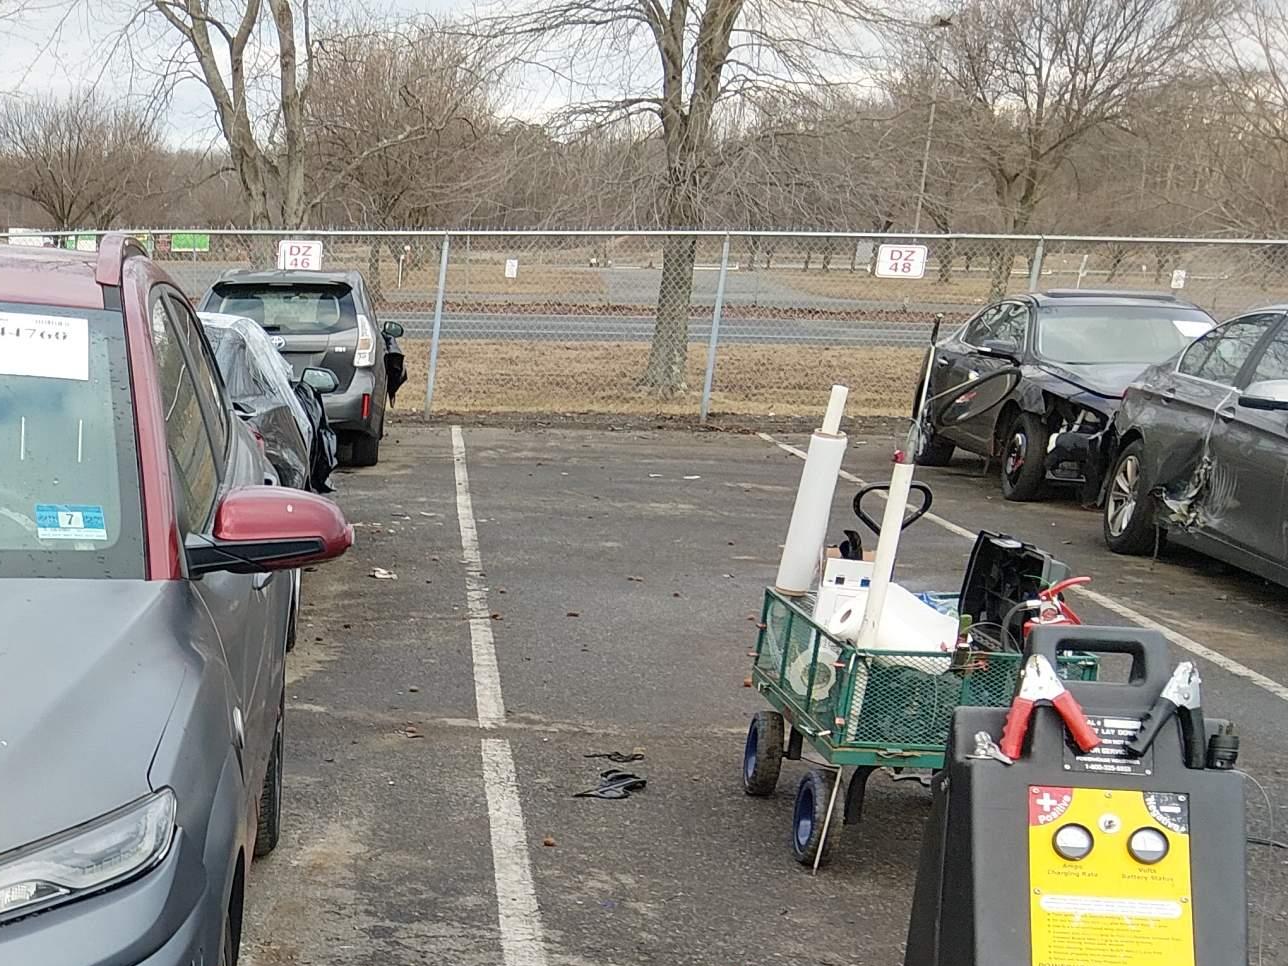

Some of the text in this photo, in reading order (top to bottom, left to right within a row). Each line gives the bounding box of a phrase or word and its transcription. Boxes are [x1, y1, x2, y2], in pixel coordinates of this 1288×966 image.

[289, 245, 313, 257] DZ
[890, 249, 917, 262] DZ
[289, 257, 310, 269] 46
[888, 262, 912, 274] 48
[65, 513, 75, 526] 7
[1037, 794, 1072, 825] Positive
[1144, 794, 1187, 833] Negative
[1047, 869, 1081, 879] Charging
